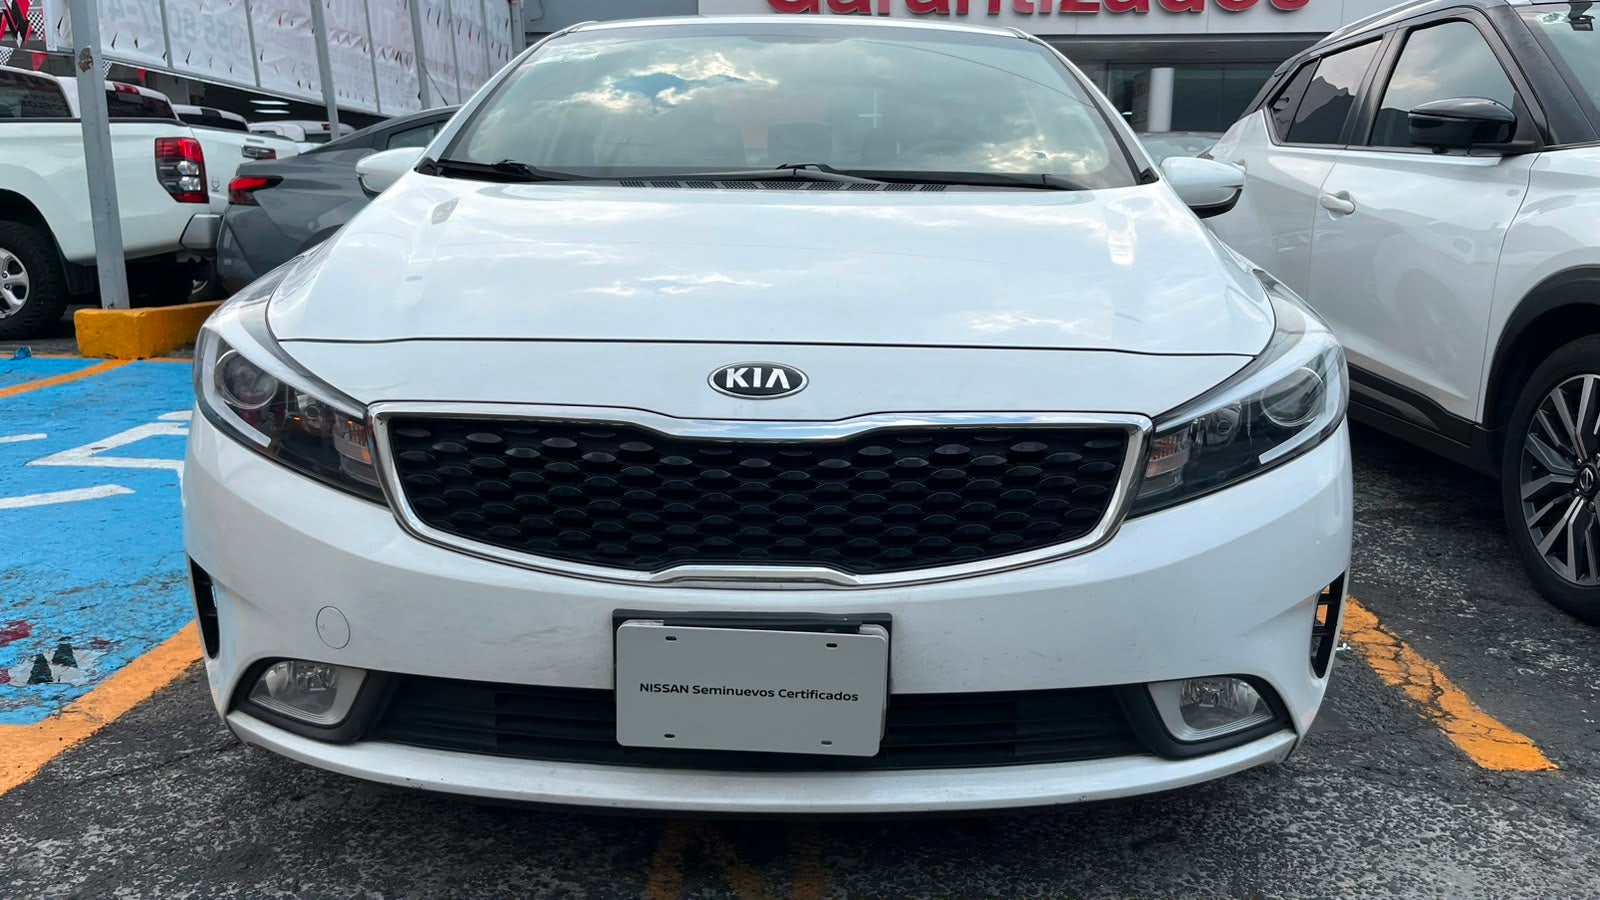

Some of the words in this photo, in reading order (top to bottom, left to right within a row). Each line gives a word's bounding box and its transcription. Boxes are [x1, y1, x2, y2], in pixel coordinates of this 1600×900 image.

[725, 367, 791, 389] KIA
[639, 682, 690, 694] NISSAN
[692, 684, 775, 698] Seminuevos
[778, 688, 859, 702] Certificados
